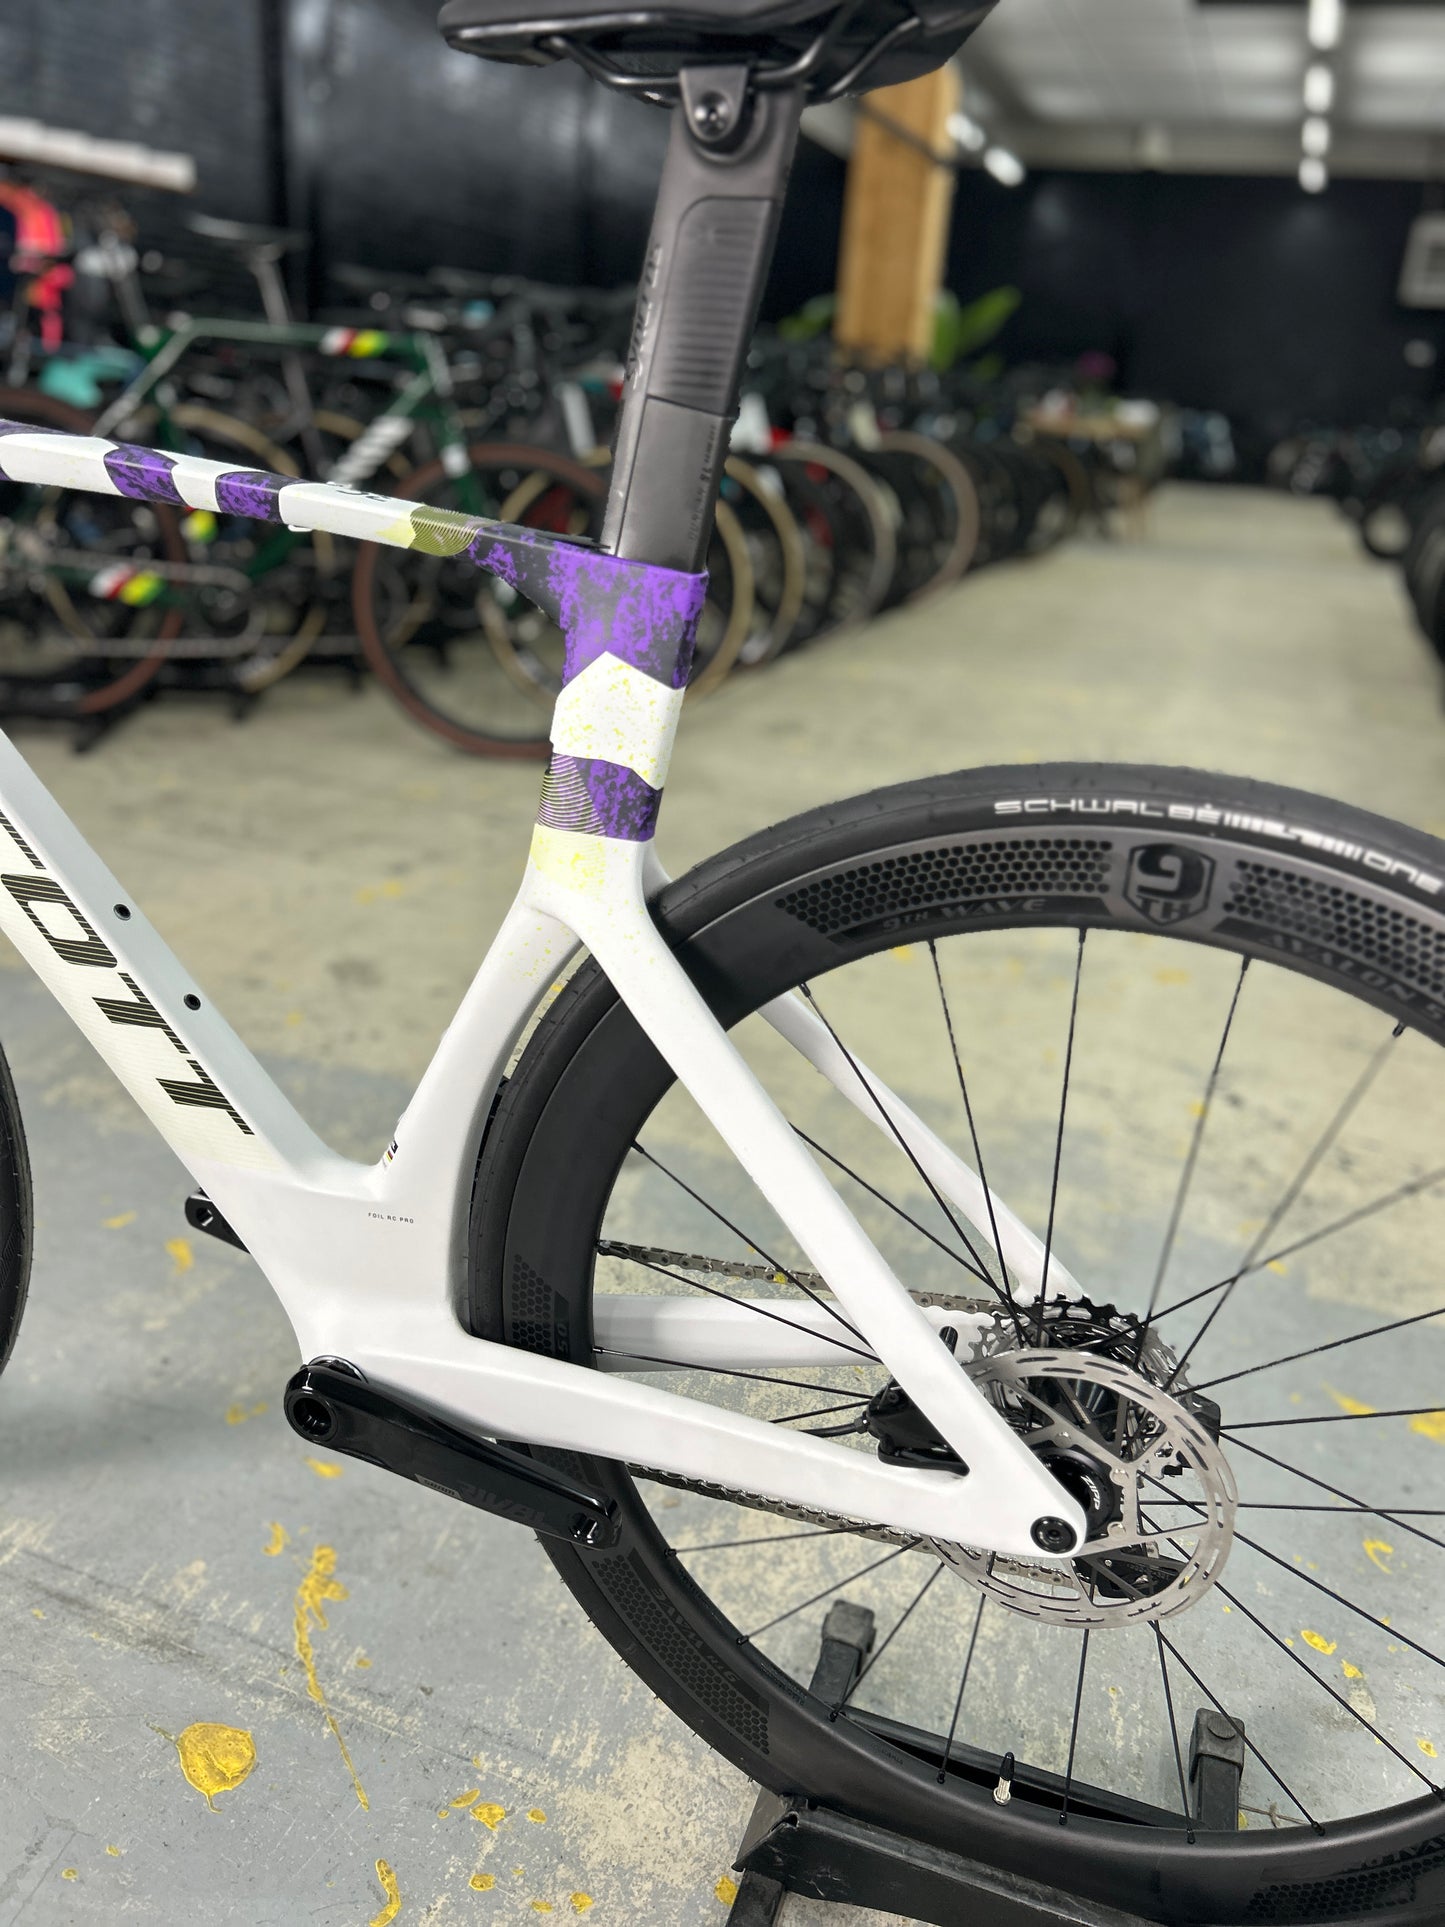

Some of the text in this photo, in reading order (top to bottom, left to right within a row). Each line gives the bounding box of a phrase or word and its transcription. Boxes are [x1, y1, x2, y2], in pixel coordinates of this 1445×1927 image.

[941, 897, 1046, 920] WAVE
[0, 808, 255, 1136] OTT
[367, 1211, 414, 1224] FOIL RC PRO
[1080, 1474, 1101, 1511] ZIPP
